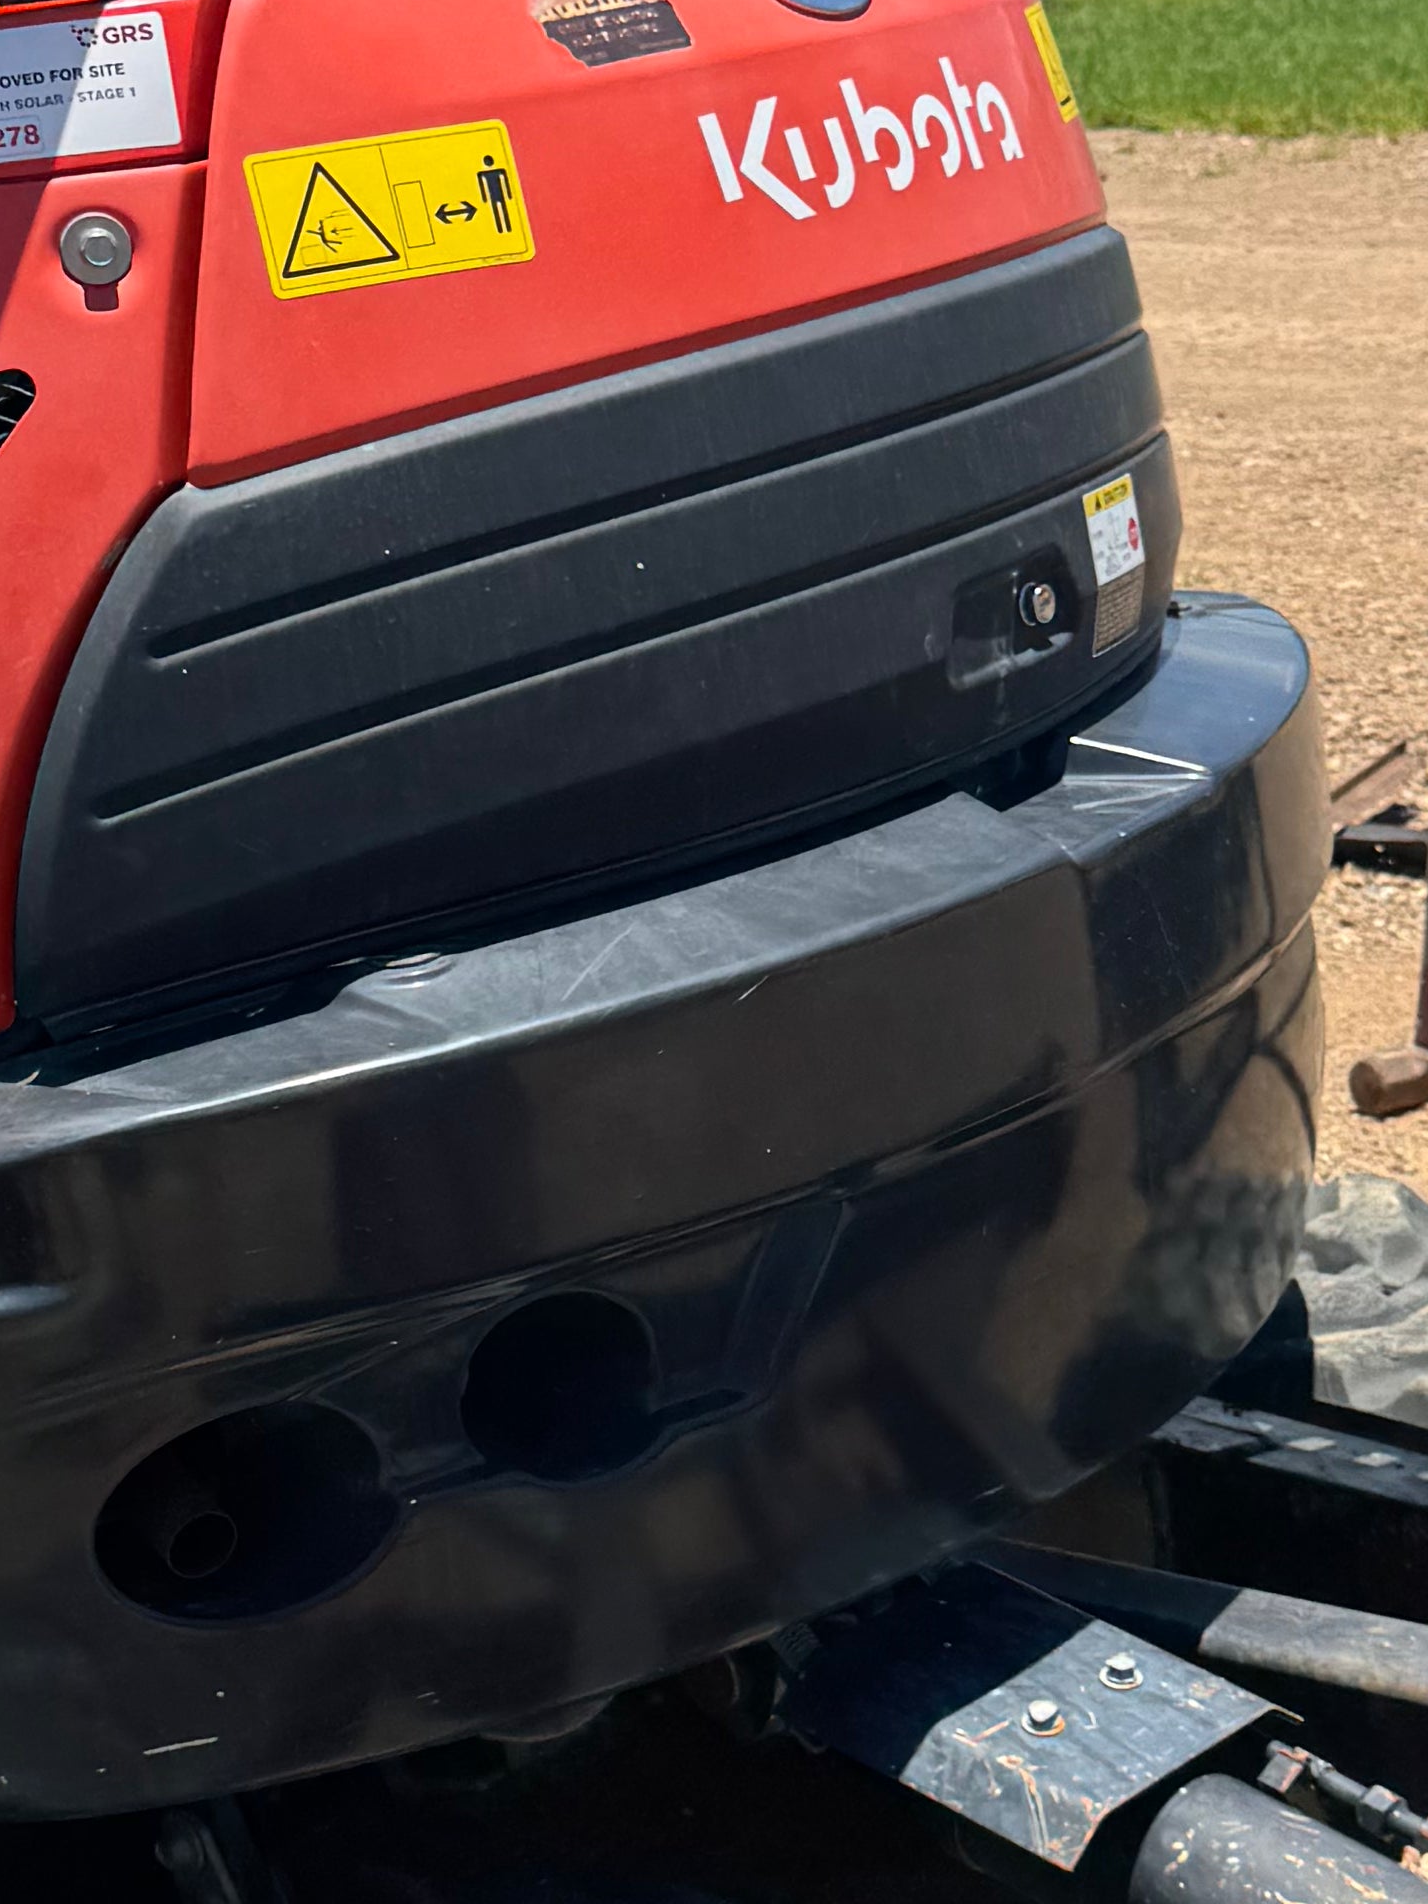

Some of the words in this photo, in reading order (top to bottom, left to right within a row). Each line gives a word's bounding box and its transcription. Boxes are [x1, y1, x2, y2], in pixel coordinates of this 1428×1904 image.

[101, 22, 154, 45] GRS
[49, 65, 84, 83] FOR
[89, 62, 126, 78] SITE
[14, 93, 65, 110] SOLAR
[79, 87, 125, 104] STAGE
[697, 56, 1025, 220] Kubota
